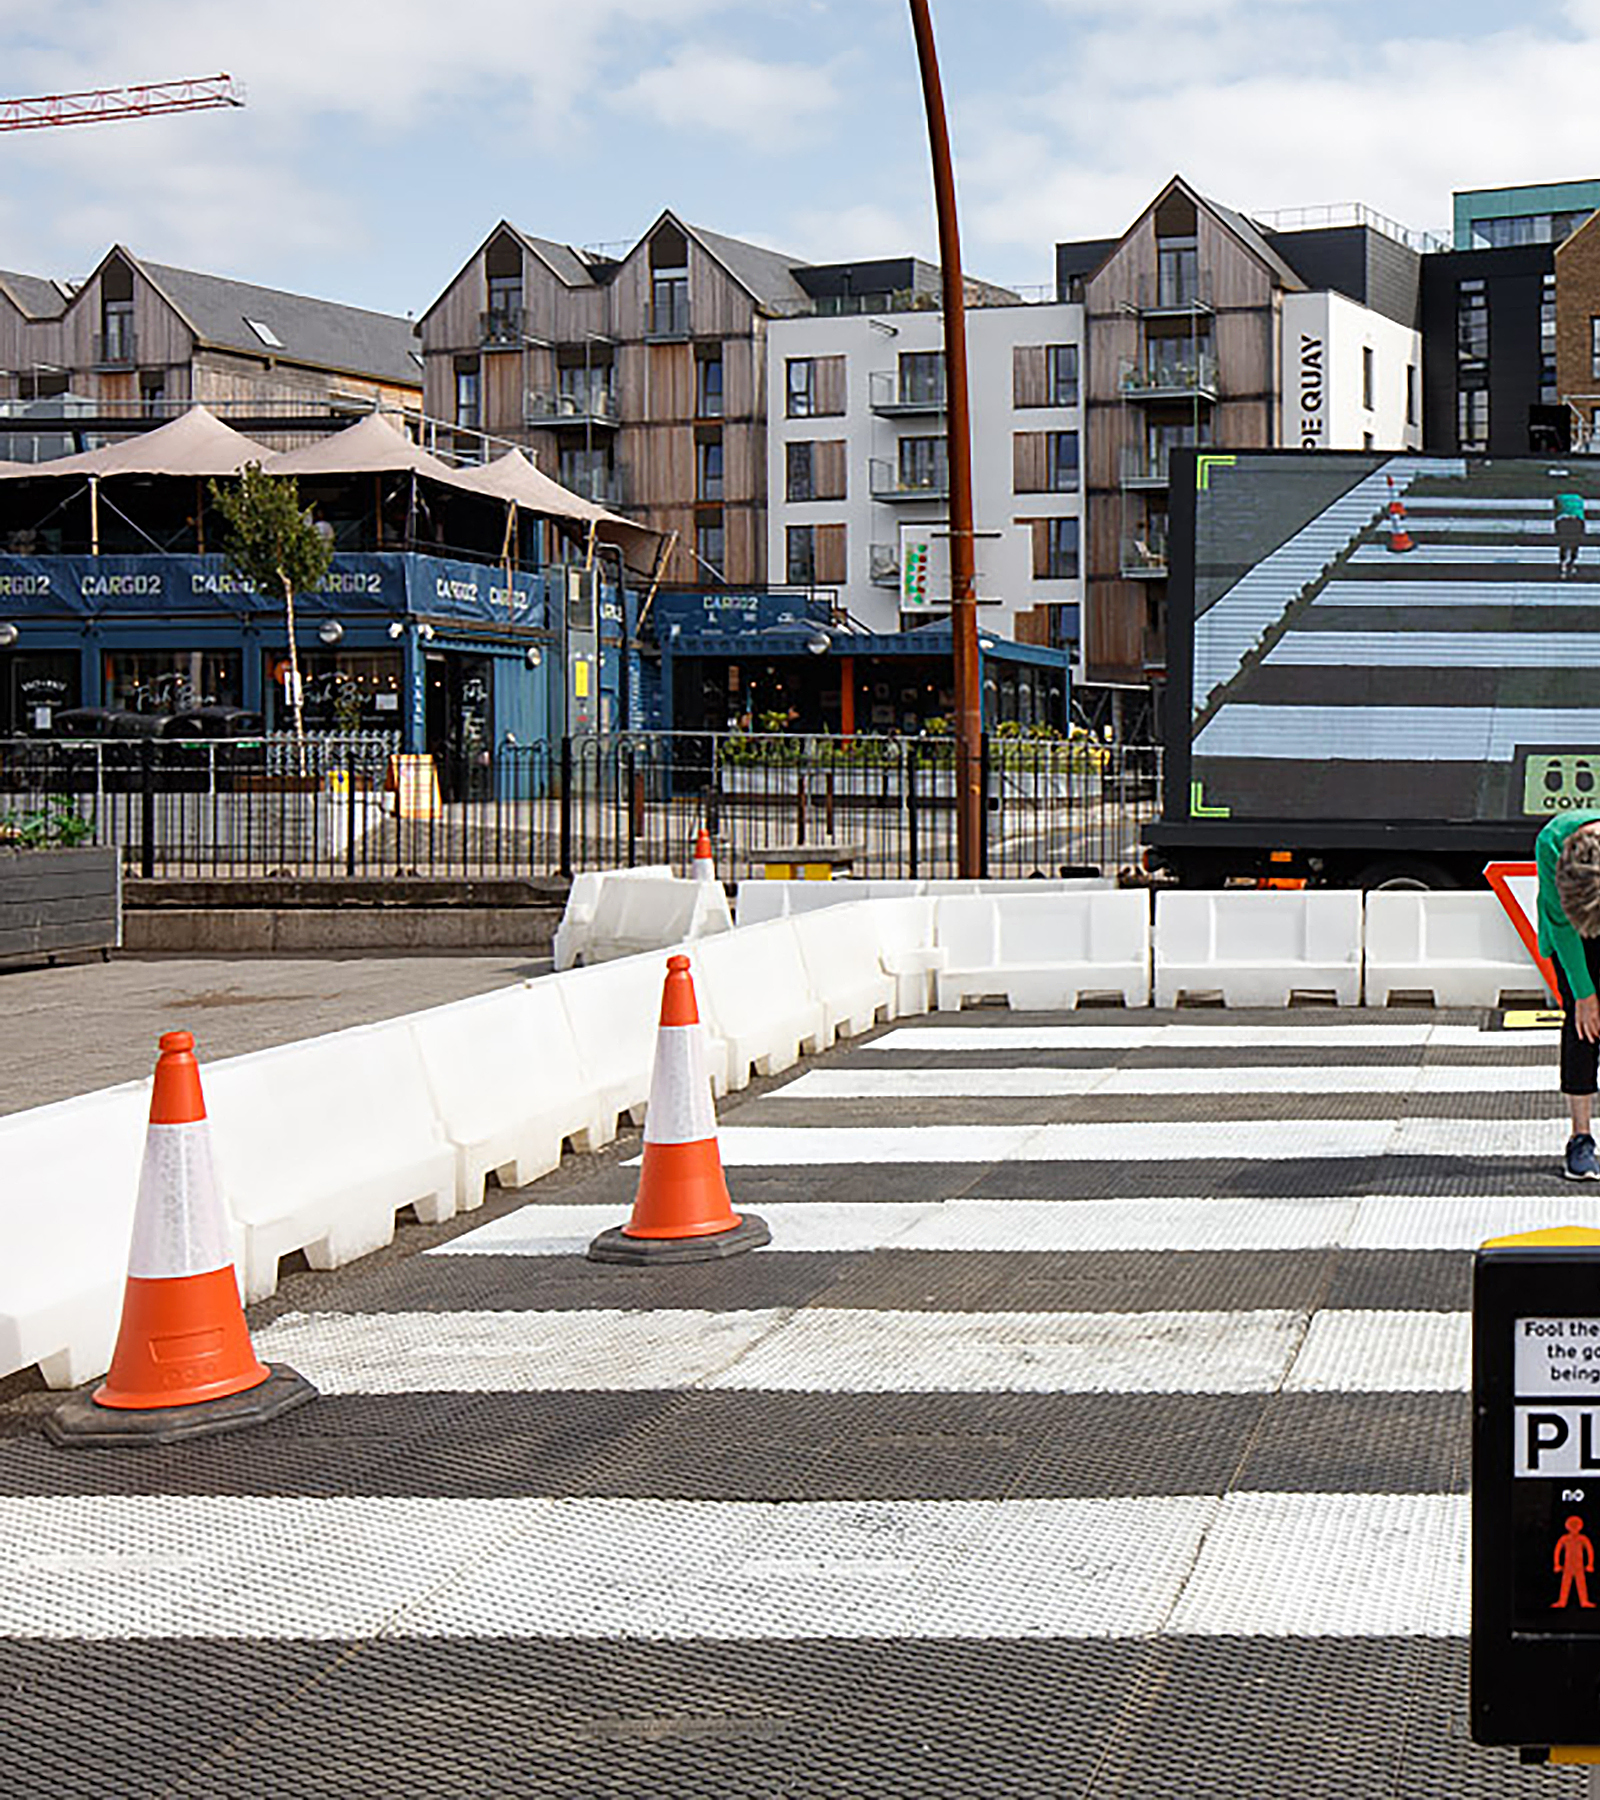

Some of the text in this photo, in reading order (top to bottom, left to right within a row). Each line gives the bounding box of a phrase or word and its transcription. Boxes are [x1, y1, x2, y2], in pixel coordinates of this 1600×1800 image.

[1301, 334, 1322, 412] QUAY
[81, 575, 161, 595] CARGO2
[1525, 1321, 1564, 1337] Fool
[1570, 1322, 1599, 1337] the
[1547, 1344, 1577, 1359] the
[1550, 1365, 1600, 1384] being
[1562, 1488, 1585, 1502] no
